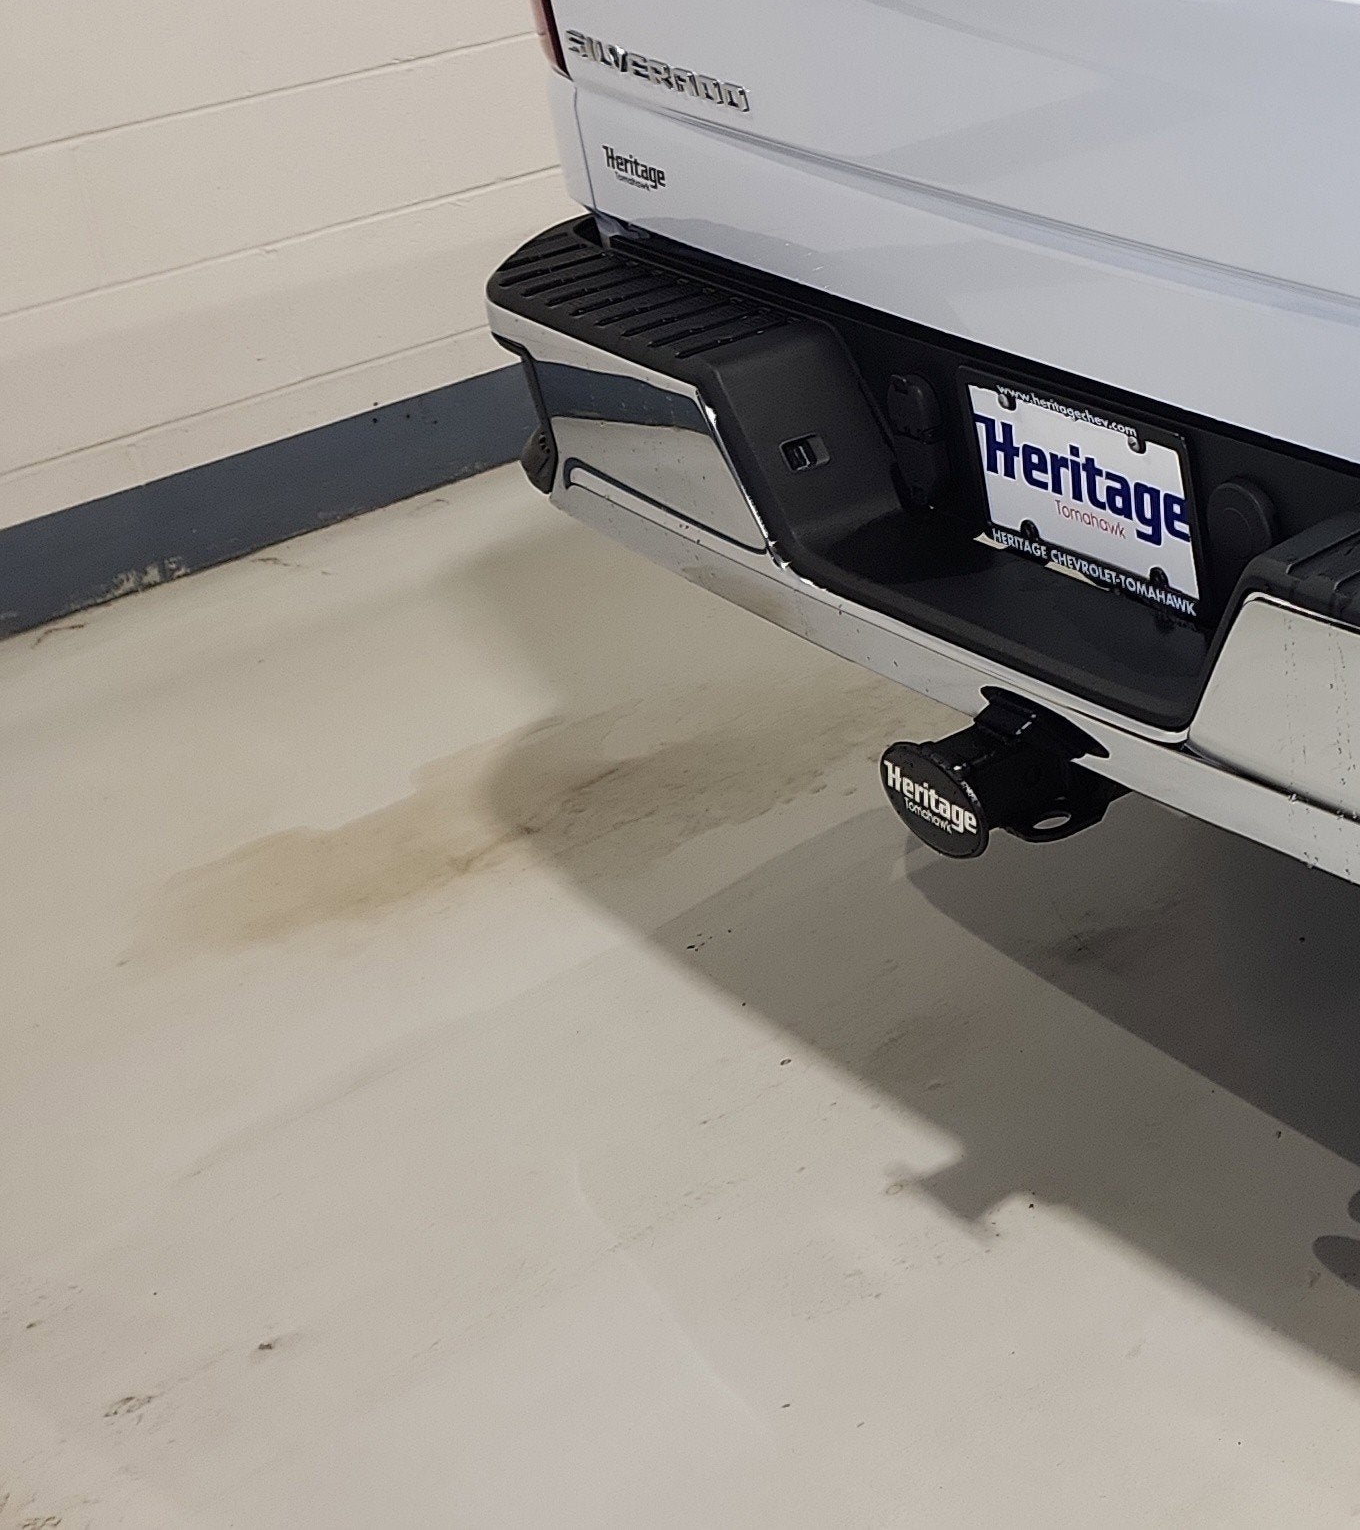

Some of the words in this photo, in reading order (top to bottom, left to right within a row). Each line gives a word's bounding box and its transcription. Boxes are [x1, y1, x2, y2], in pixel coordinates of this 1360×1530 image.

[602, 145, 666, 189] Heritage
[996, 384, 1137, 437] www.heritagechev.com
[973, 412, 1191, 546] Heritage
[1055, 499, 1127, 539] Tomahawk
[992, 528, 1048, 559] HERITAGE
[883, 759, 977, 834] Heritage
